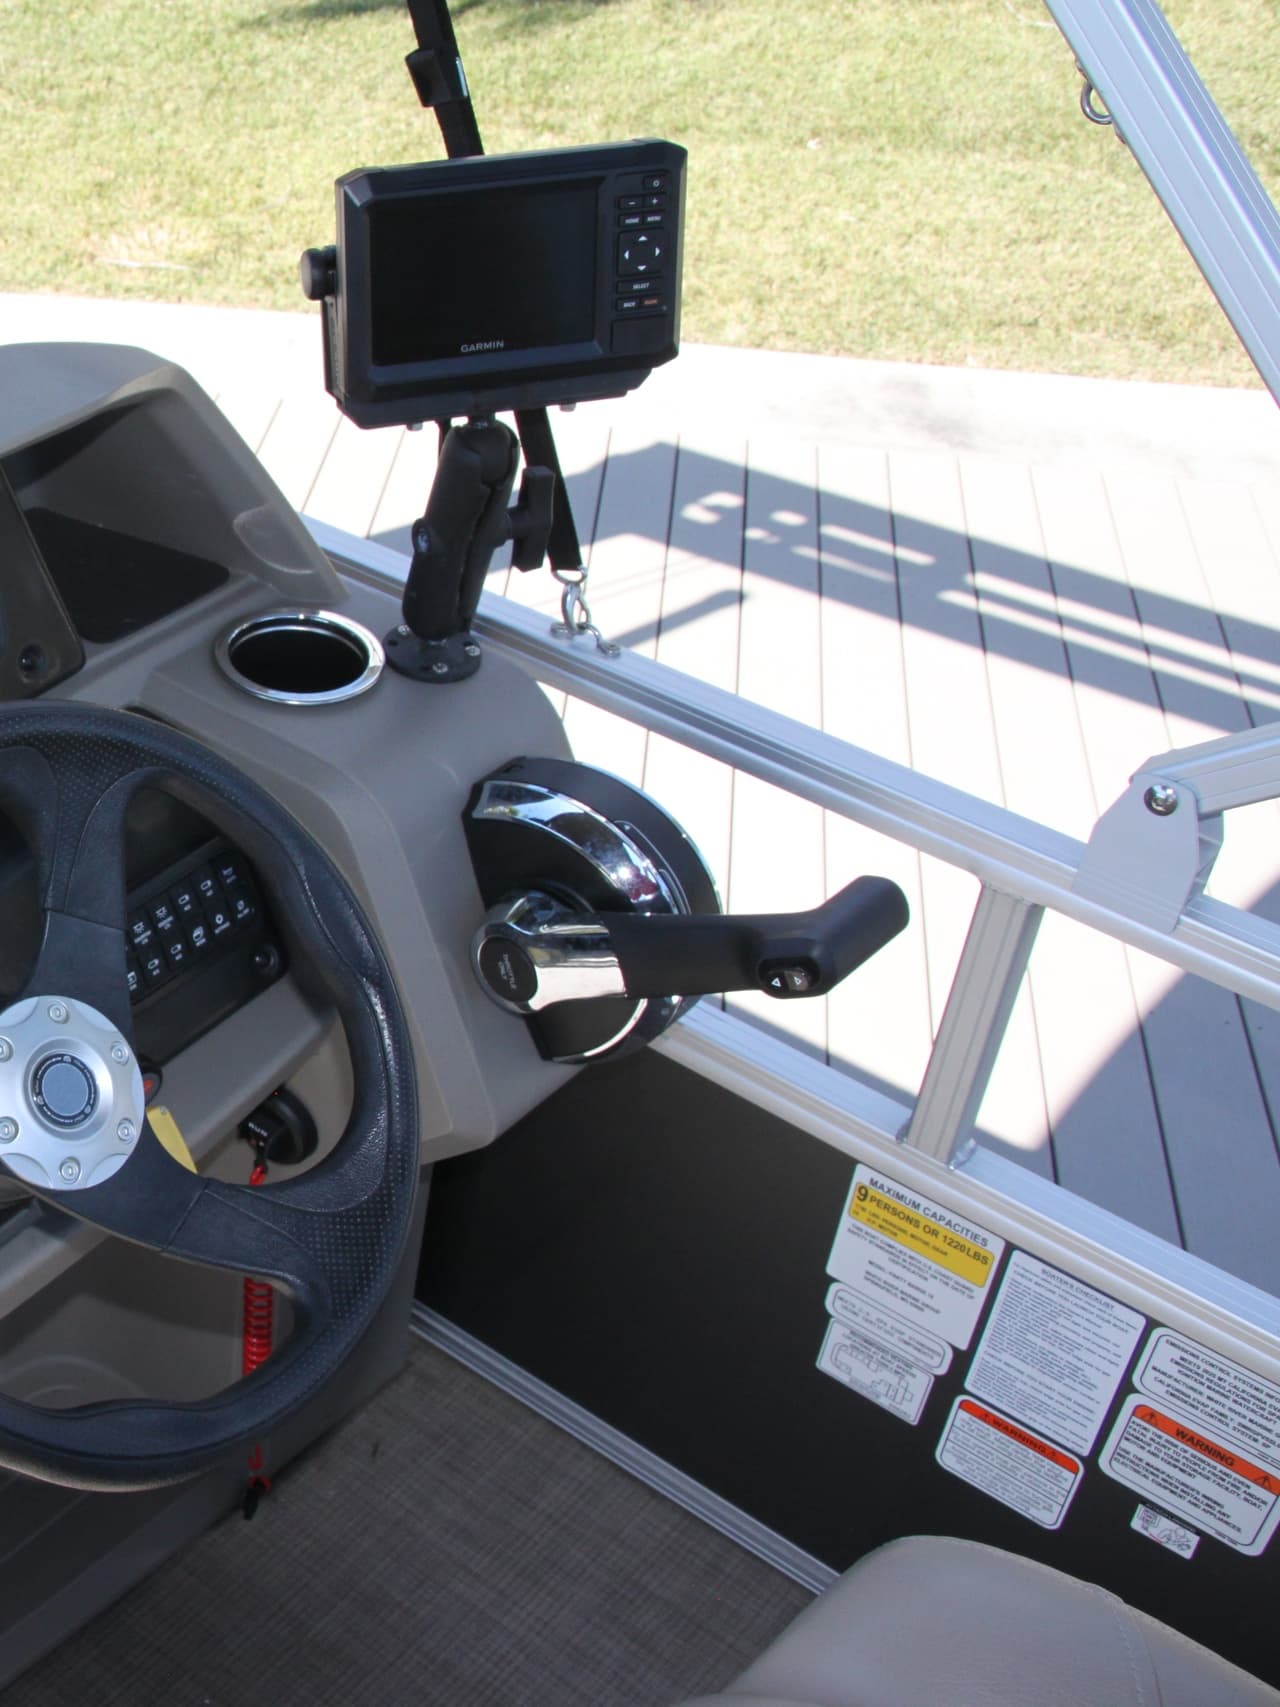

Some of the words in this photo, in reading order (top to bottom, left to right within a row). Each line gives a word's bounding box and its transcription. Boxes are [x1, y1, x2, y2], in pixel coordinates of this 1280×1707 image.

[632, 282, 650, 290] SELECT
[460, 339, 505, 353] GARMIN
[856, 1184, 869, 1203] 9
[868, 1193, 921, 1229] PERSONS
[921, 1222, 939, 1239] OR
[868, 1176, 921, 1211] MAXIMUM
[921, 1205, 989, 1248] CAPACITIES
[1074, 1285, 1115, 1311] CHECKLIST
[1152, 1375, 1192, 1400] CALIFORNIA
[1191, 1396, 1210, 1410] EVAP
[1164, 1337, 1201, 1361] EMISSIONS
[1199, 1356, 1232, 1378] CONTROL
[1231, 1374, 1264, 1395] SYSTEMS
[1169, 1357, 1205, 1380] EMISSIONS
[1204, 1376, 1251, 1405] REGULATIONS
[1250, 1401, 1266, 1413] FOR
[1178, 1354, 1201, 1371] MEETS
[1226, 1381, 1268, 1407] CALIFORNIA
[1164, 1388, 1199, 1411] EMISSIONS
[1198, 1407, 1231, 1428] CONTROL
[1176, 1368, 1206, 1387] IGNITION
[1205, 1383, 1231, 1401] MARINE
[1230, 1397, 1277, 1426] WATERCRAFT
[1204, 1393, 1226, 1409] WHITE
[1226, 1405, 1248, 1420] RIVER
[1247, 1416, 1274, 1435] MARINE
[991, 1417, 1047, 1454] WARNING
[1122, 1435, 1147, 1452] MOTOR
[1145, 1448, 1160, 1459] AND
[1124, 1429, 1153, 1449] DAMAGE
[1152, 1445, 1163, 1455] TO
[1162, 1450, 1181, 1465] YOUR
[1180, 1461, 1211, 1482] STORAGE
[1127, 1424, 1148, 1439] FATAL
[1147, 1435, 1172, 1453] INJURY
[1171, 1448, 1181, 1458] TO
[1180, 1454, 1207, 1472] PEOPLE
[1206, 1468, 1227, 1483] FROM
[1226, 1479, 1242, 1492] FIRE
[1130, 1419, 1151, 1434] AVOID
[1150, 1430, 1164, 1441] THE
[1162, 1437, 1179, 1450] RISK
[1178, 1446, 1188, 1455] OF
[1189, 1452, 1218, 1471] SERIOUS
[1217, 1467, 1233, 1480] AND
[1231, 1475, 1251, 1490] EVEN
[1174, 1427, 1236, 1468] WARNING
[1115, 1451, 1160, 1480] INSTRUCTIONS
[1159, 1476, 1180, 1491] WHEN
[1179, 1487, 1216, 1511] INSTALLING
[1216, 1508, 1232, 1520] ANY
[1117, 1445, 1132, 1457] USE
[1130, 1453, 1143, 1464] THE
[1200, 1492, 1225, 1510] WIRING
[1150, 1477, 1187, 1502] EQUIPMENT
[1186, 1498, 1202, 1510] AND
